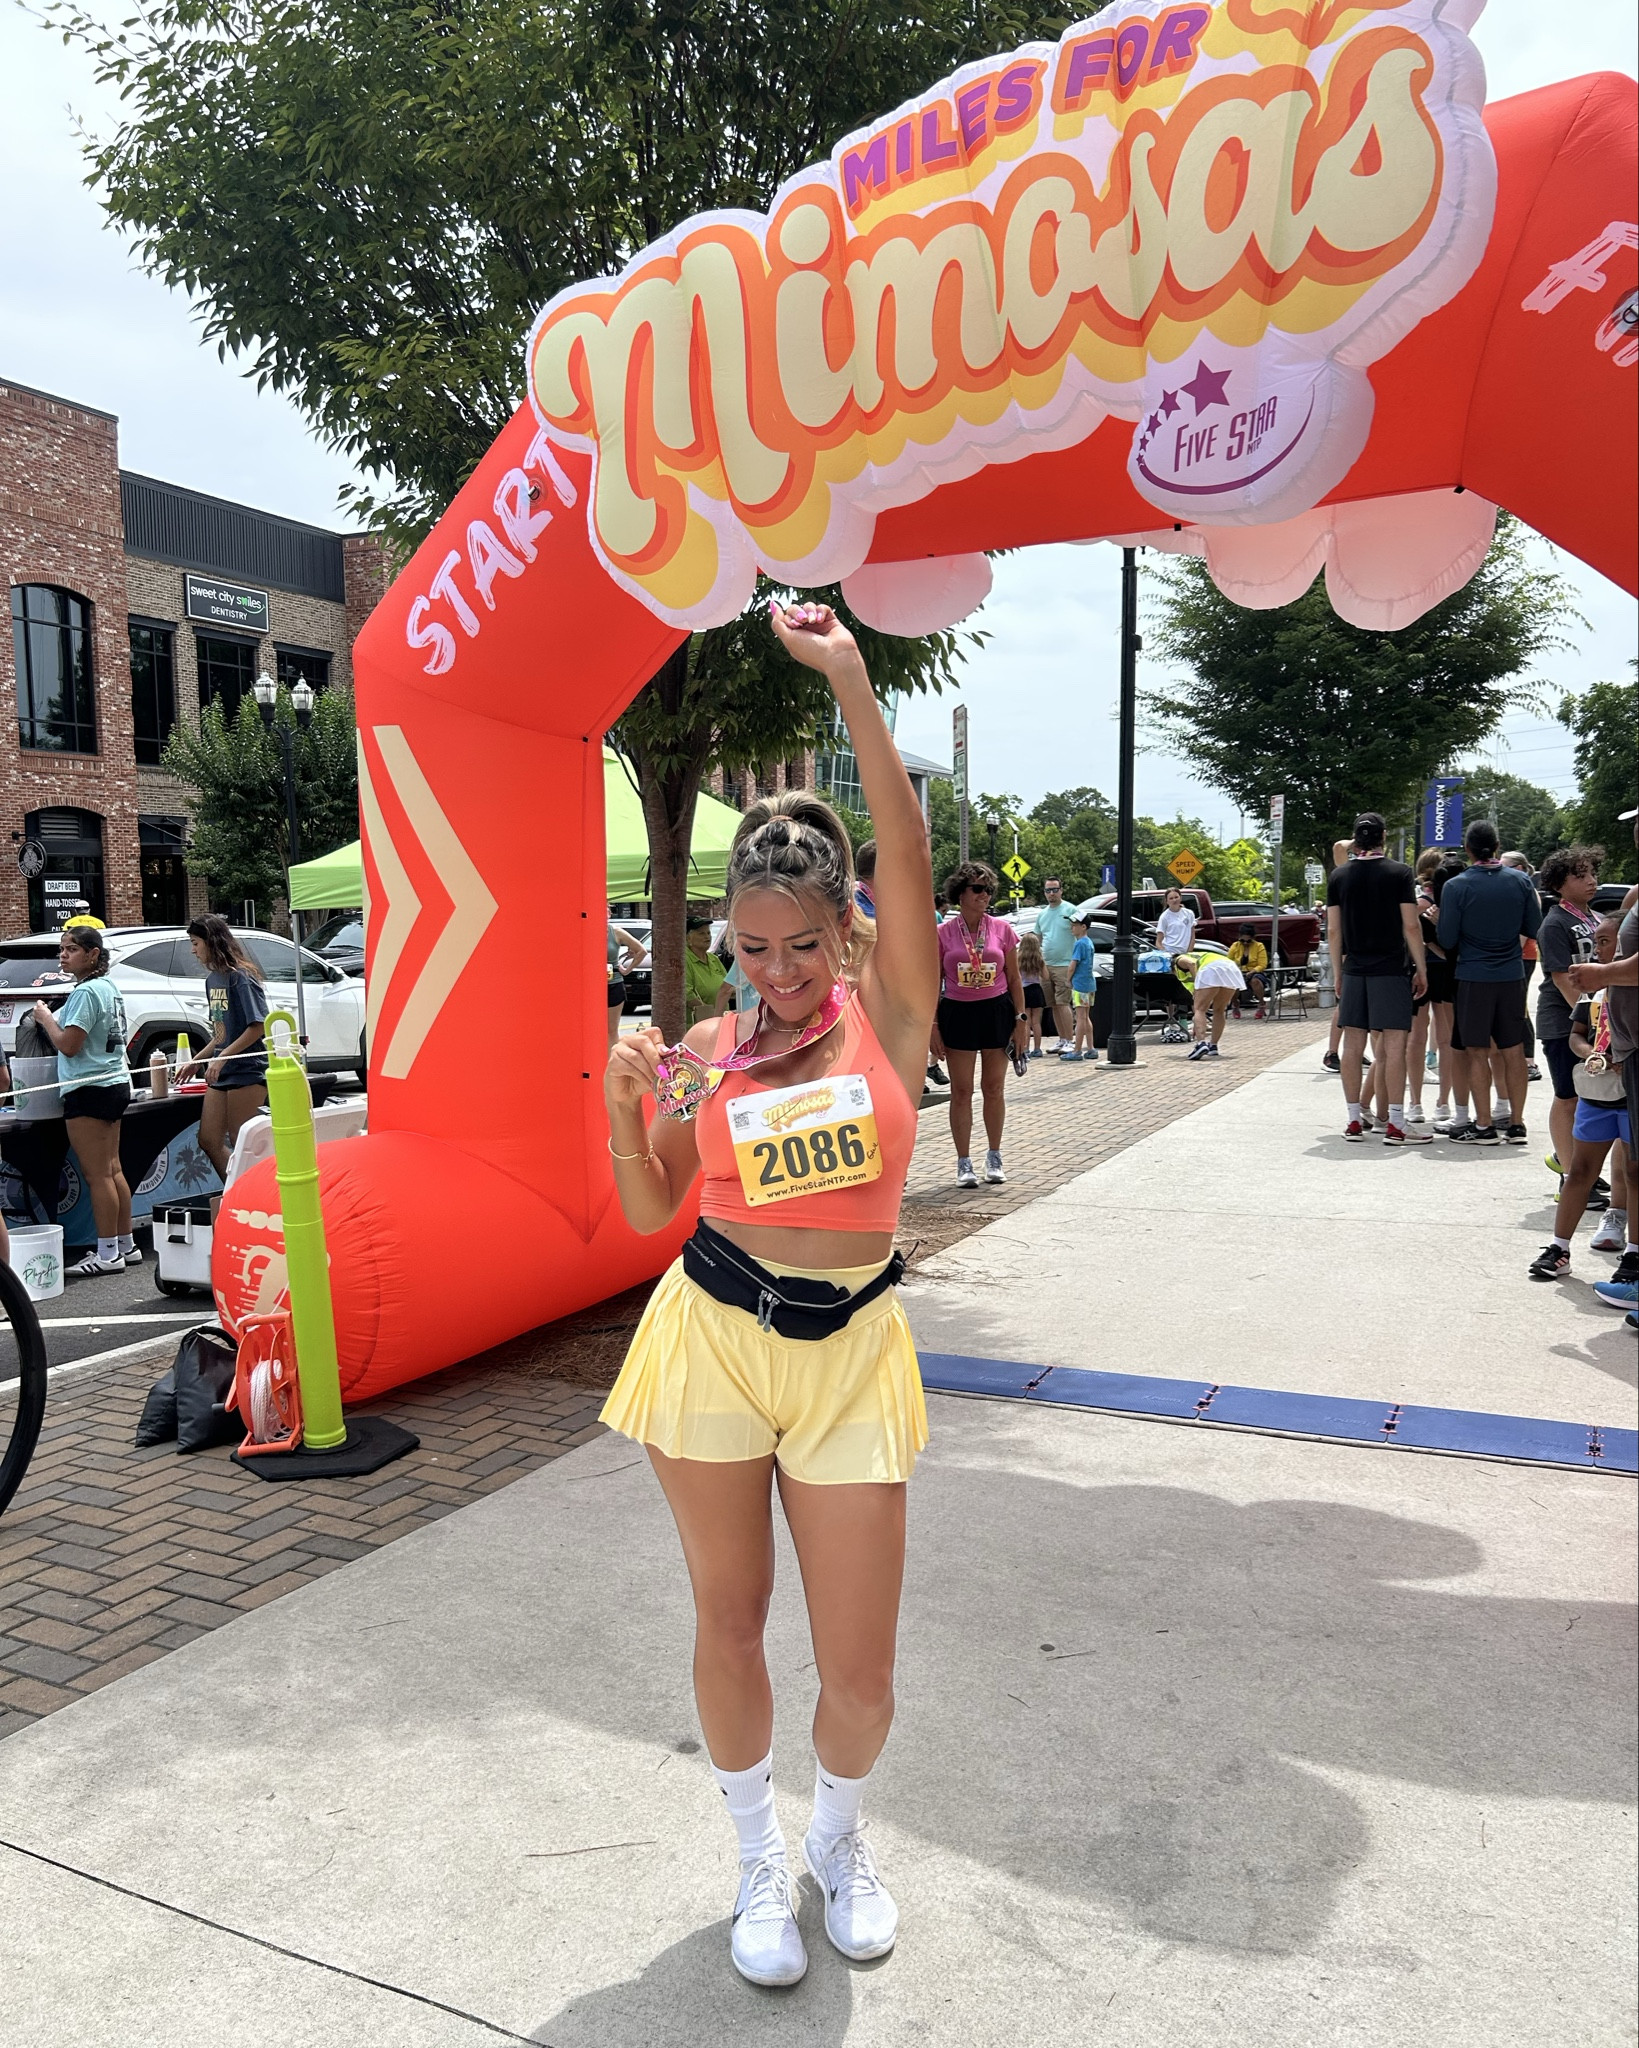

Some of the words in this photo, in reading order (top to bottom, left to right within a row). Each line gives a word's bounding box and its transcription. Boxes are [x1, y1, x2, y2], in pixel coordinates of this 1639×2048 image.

[843, 66, 1038, 211] MILES
[1064, 7, 1210, 102] FOR
[533, 46, 1438, 558] Mimosas
[1174, 424, 1219, 473] FIVE
[1226, 396, 1278, 461] STAR
[406, 428, 578, 676] START
[191, 586, 217, 600] sweet
[219, 591, 235, 605] city
[237, 596, 262, 609] smiles
[211, 606, 248, 620] DENTISTRY
[48, 882, 64, 890] DRAFT
[65, 882, 78, 891] BEER
[57, 911, 71, 919] PIZZA
[660, 1085, 710, 1119] Mimosas
[663, 1080, 689, 1097] Miles
[753, 1124, 865, 1187] 2086
[766, 1172, 867, 1199] www.FiveStarNTP.com
